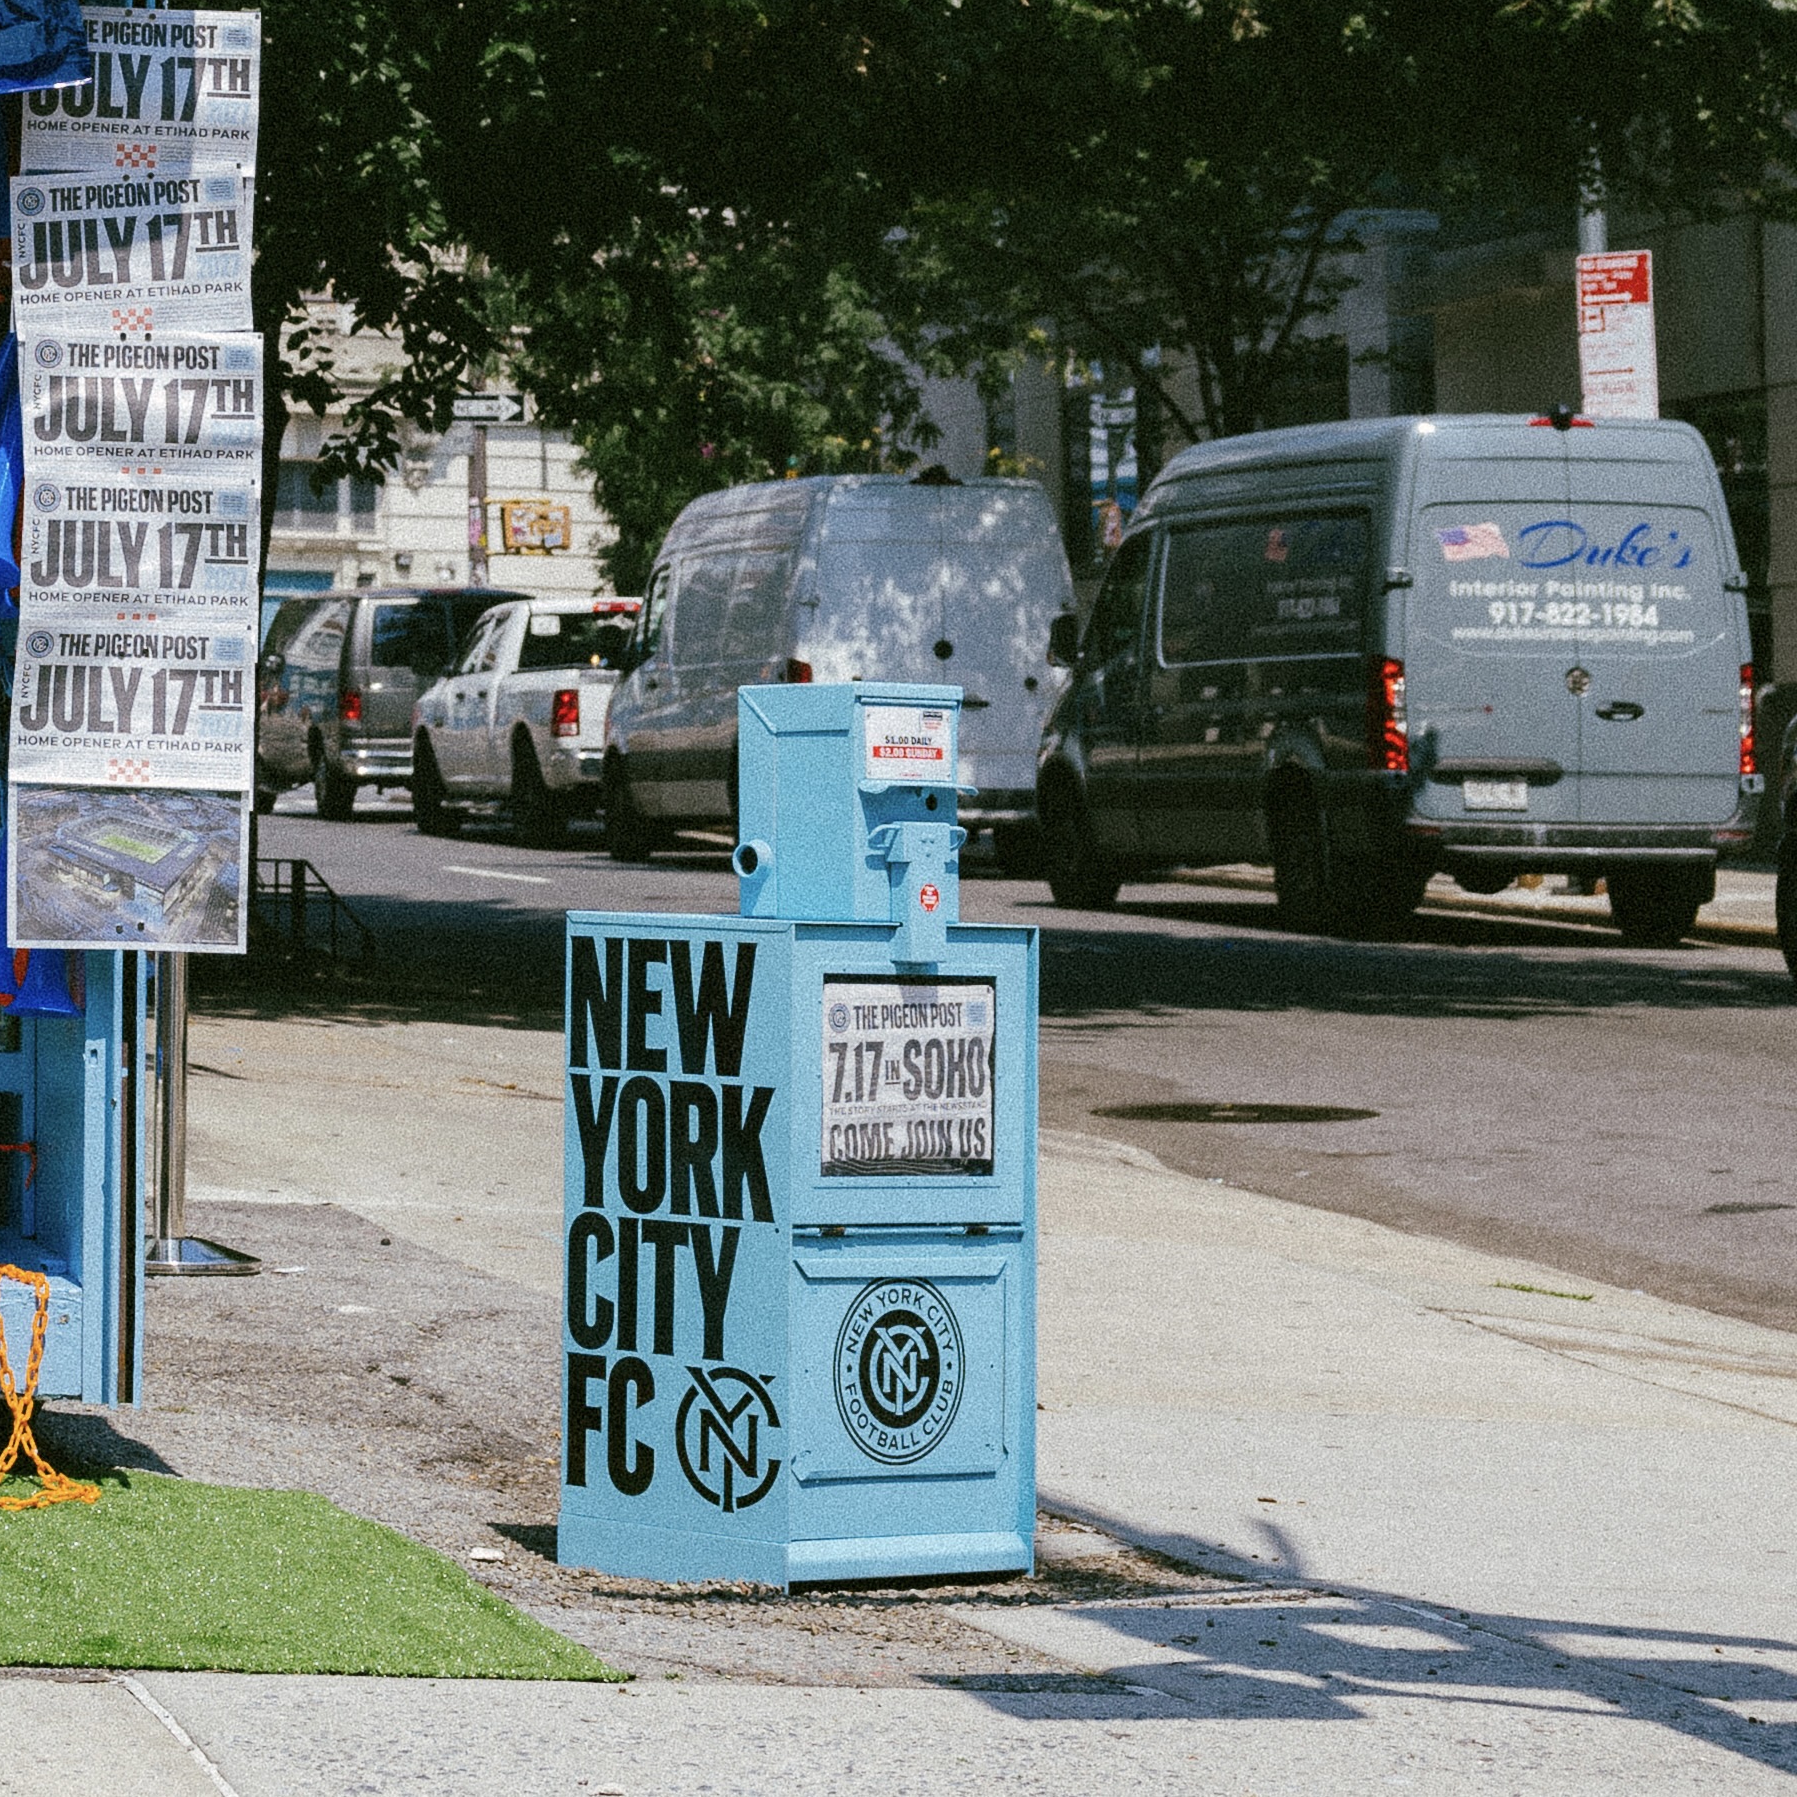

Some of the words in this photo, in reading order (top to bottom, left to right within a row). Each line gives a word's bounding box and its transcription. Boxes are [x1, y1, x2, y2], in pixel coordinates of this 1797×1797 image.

[101, 23, 166, 48] PIGEON
[171, 25, 217, 49] POST
[160, 57, 251, 123] 17TH
[50, 186, 82, 212] THE
[85, 182, 150, 209] PIGEON
[154, 180, 200, 206] POST
[18, 222, 26, 259] NYCFC
[20, 213, 143, 290] JULY
[147, 210, 238, 282] 17TH
[20, 293, 61, 305] HOME
[64, 290, 122, 302] OPENER
[125, 288, 143, 299] AT
[148, 285, 201, 298] ETIHAD
[205, 282, 243, 294] PARK
[67, 343, 100, 367] THE
[105, 345, 169, 368] PIGEON
[173, 345, 220, 369] POST
[34, 376, 156, 443] JULY
[163, 379, 254, 444] 17TH
[65, 487, 97, 512] THE
[102, 488, 165, 513] PIGEON
[168, 490, 213, 514] POST
[30, 520, 153, 589] JULY
[158, 522, 248, 590] 17TH
[31, 518, 40, 554] NYCFC
[1519, 520, 1691, 569] Duke's
[1450, 580, 1540, 597] Interior
[1545, 580, 1644, 601] Painting
[1650, 583, 1691, 600] Inc.
[59, 634, 91, 657] THE
[95, 635, 158, 659] PIGEON
[162, 636, 209, 660] POST
[19, 665, 142, 733] JULY
[152, 668, 242, 736] 17TH
[879, 747, 904, 758] $2.00
[906, 748, 938, 759] SUNDAY
[885, 736, 909, 745] $1.00
[911, 737, 932, 746] DAILY
[569, 935, 757, 1078] NEW
[853, 1005, 877, 1030] THE
[881, 1004, 928, 1029] PIGEON
[931, 1003, 963, 1027] POST
[829, 1041, 884, 1103] 7.17
[885, 1060, 900, 1080] IN
[903, 1037, 985, 1101] SOHO
[923, 1104, 937, 1112] THE
[939, 1103, 987, 1111] NEWSSTAND
[569, 1074, 776, 1223] YORK
[829, 1122, 894, 1160] COME
[901, 1120, 953, 1159] JOIN
[958, 1117, 986, 1157] US
[567, 1210, 741, 1360] CITY
[846, 1303, 873, 1353] NEW
[876, 1288, 925, 1309] YORK
[927, 1306, 954, 1351] CITY
[565, 1352, 656, 1496] FC
[845, 1383, 920, 1450] FOOTBALL
[923, 1380, 953, 1436] CLUB
